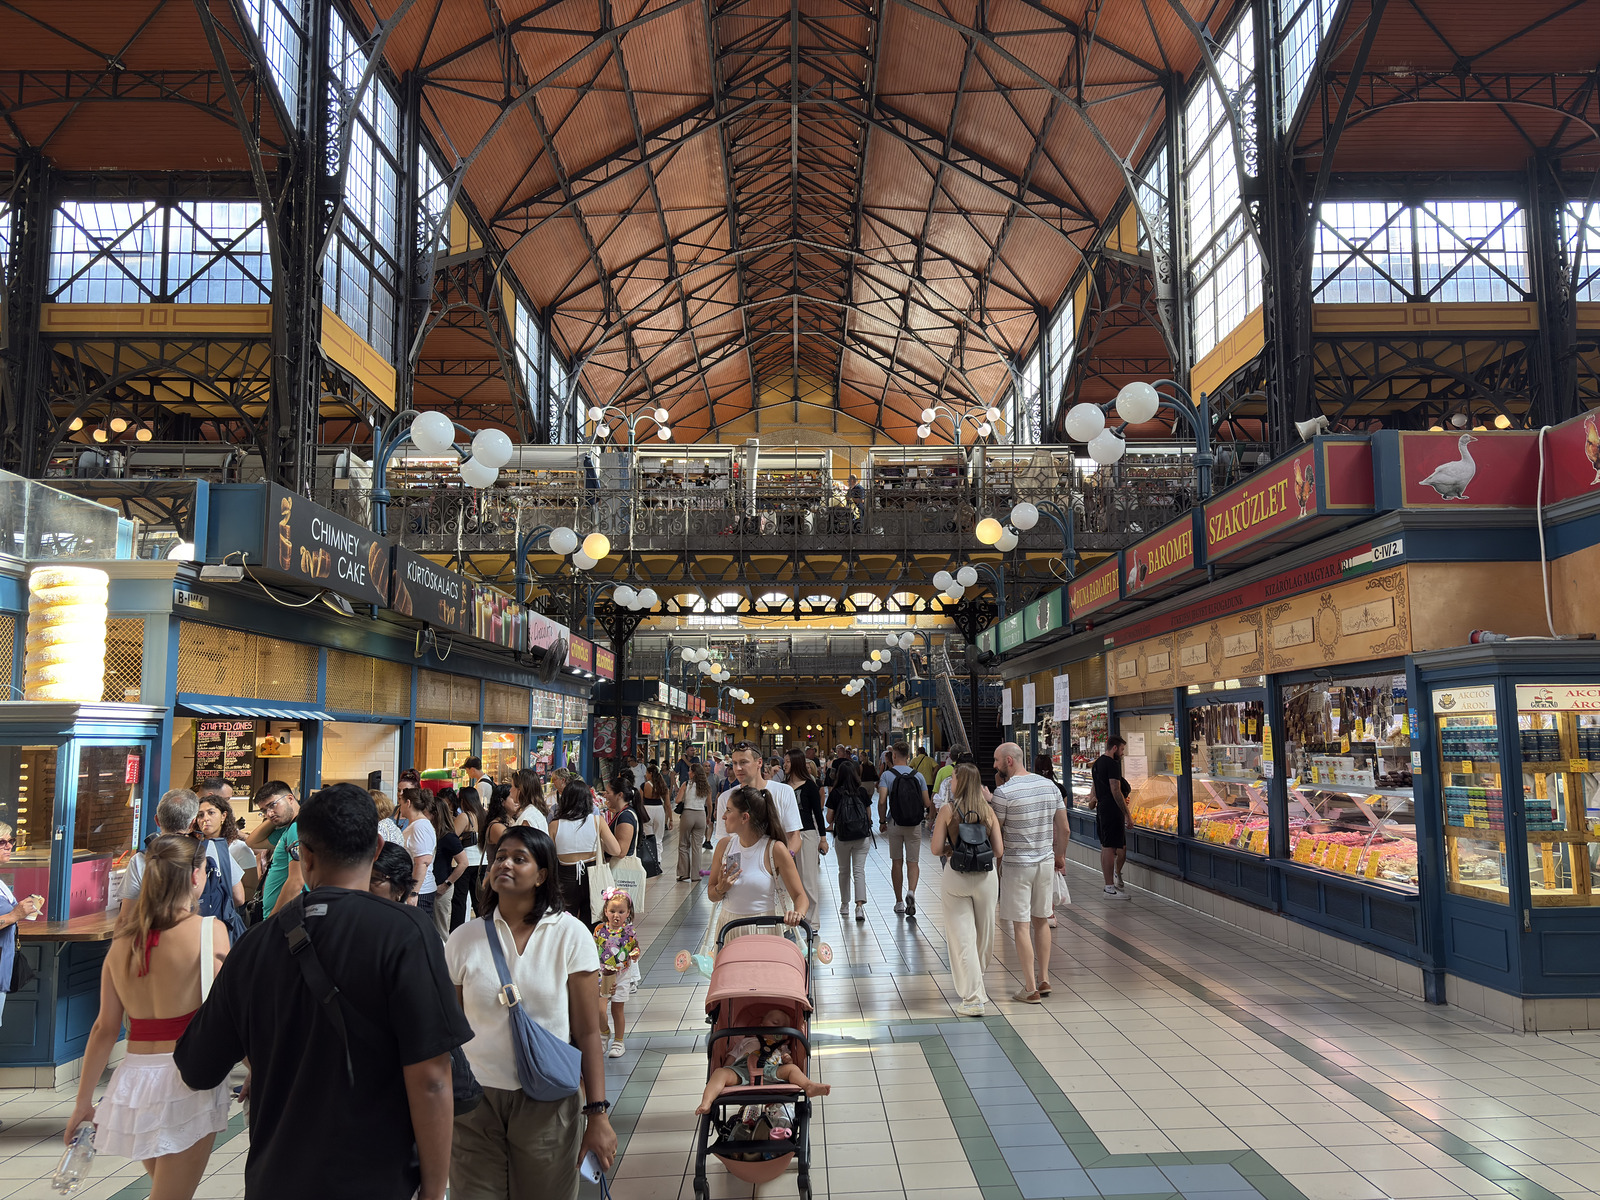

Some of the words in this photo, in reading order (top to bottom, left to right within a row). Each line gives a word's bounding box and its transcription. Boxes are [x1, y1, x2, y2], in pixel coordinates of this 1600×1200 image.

[1209, 478, 1288, 545] SZAKÜZLET
[311, 518, 360, 557] CHIMNEY
[1147, 530, 1193, 575] BAROMFI
[337, 556, 366, 586] CAKE
[1264, 574, 1303, 598] KIZÁRÓLAG
[1303, 565, 1336, 584] MAGYAR
[1336, 557, 1354, 575] ÁRU
[1458, 689, 1490, 699] AKCIÓS
[1461, 701, 1488, 710] ÁRON!
[200, 722, 232, 731] STUFFED
[233, 721, 253, 731] CONES
